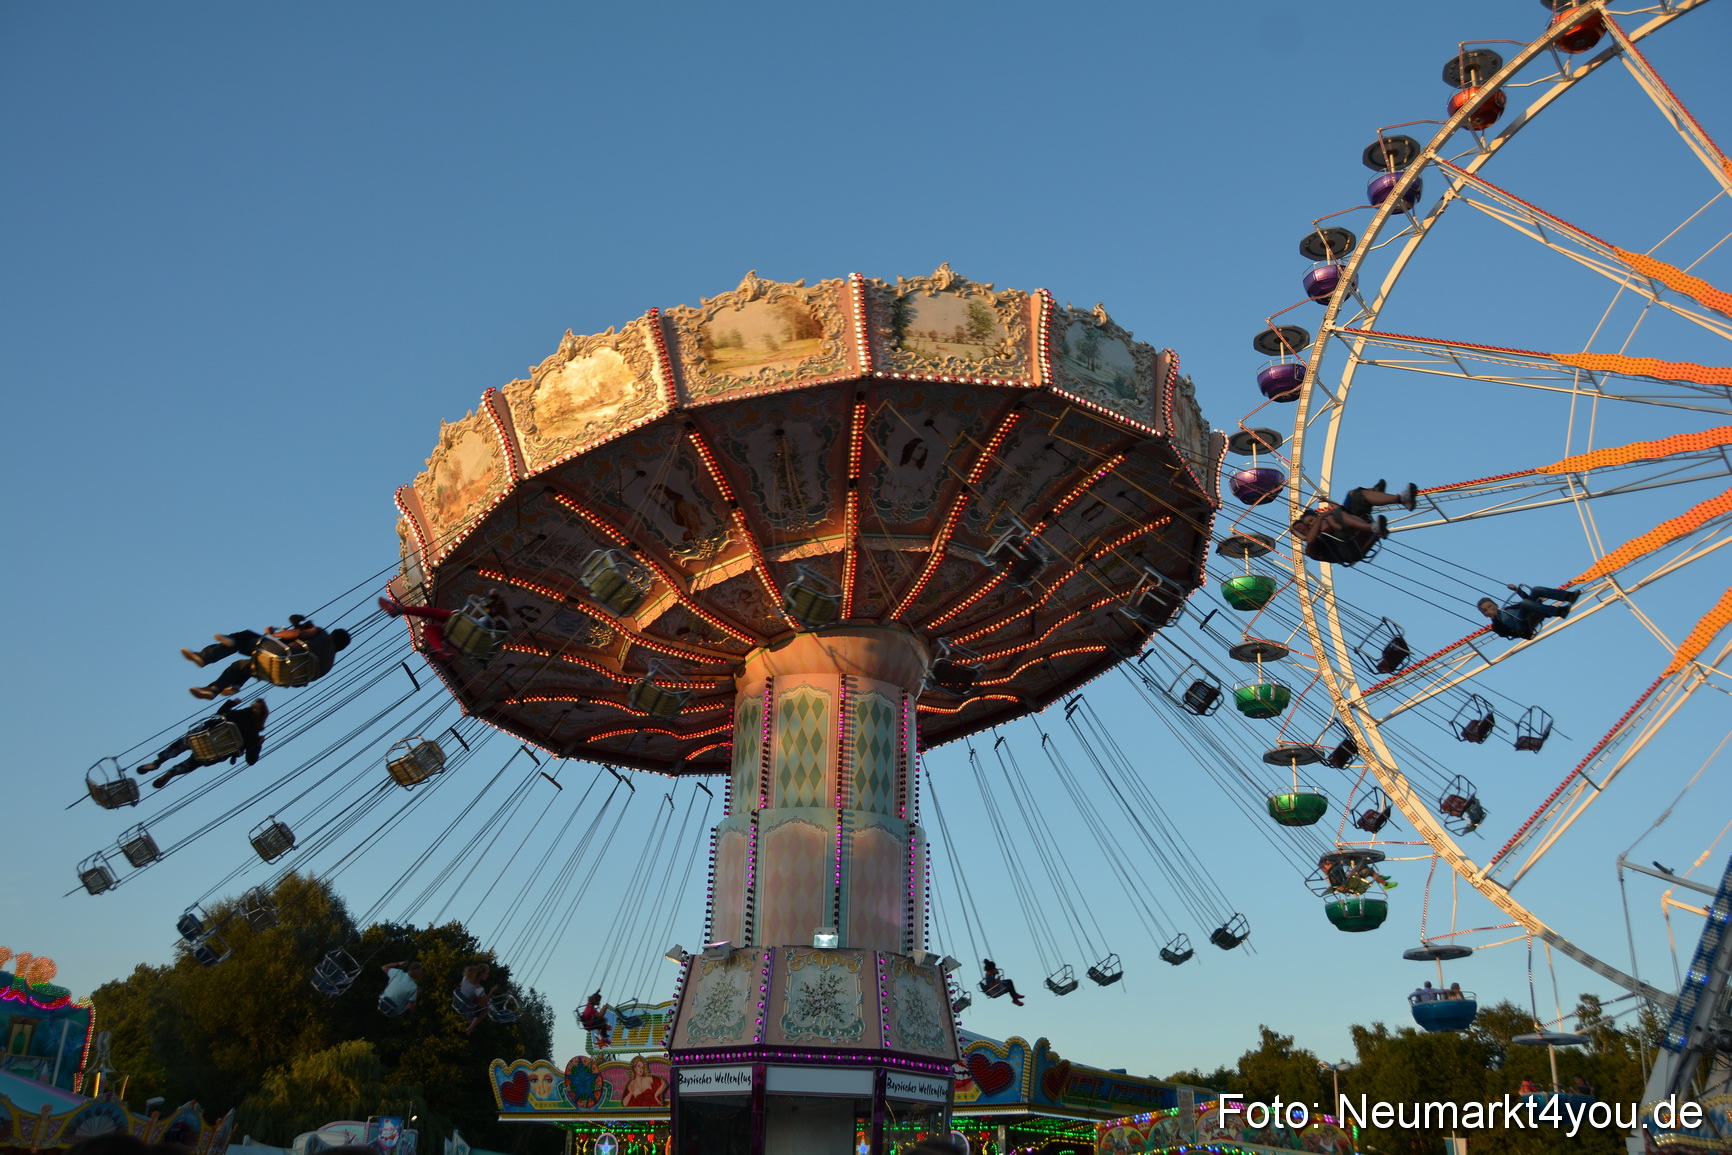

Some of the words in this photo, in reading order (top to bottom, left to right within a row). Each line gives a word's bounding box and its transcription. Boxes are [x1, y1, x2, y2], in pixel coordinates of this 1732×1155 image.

[678, 1072, 712, 1087] Bayrischer
[715, 1071, 752, 1086] Wellenflug
[887, 1077, 917, 1093] Bayrischer
[918, 1082, 949, 1099] Wellenflug
